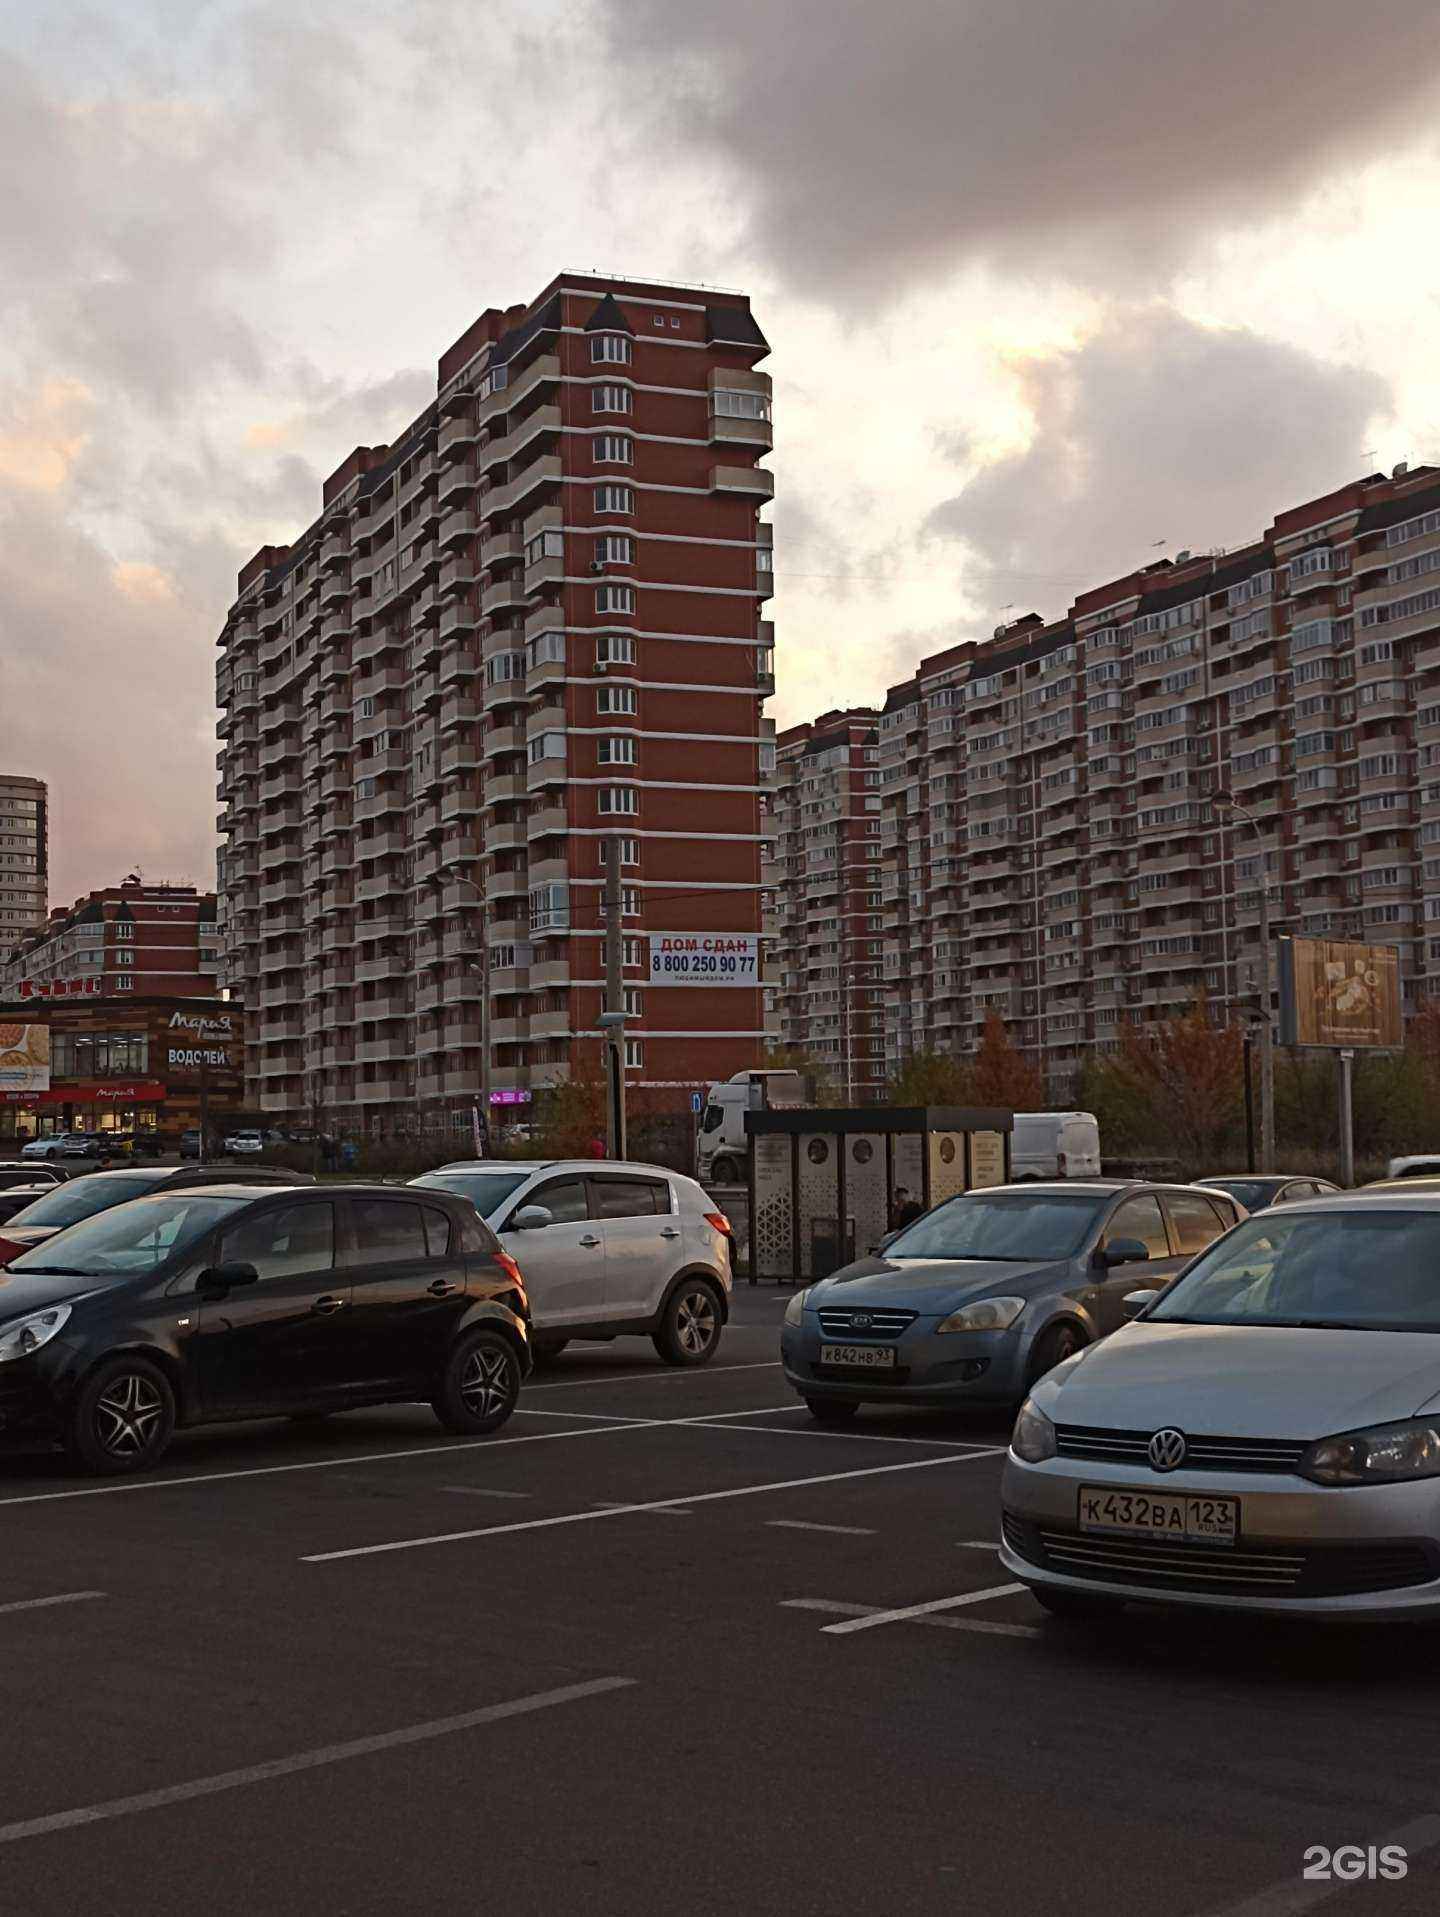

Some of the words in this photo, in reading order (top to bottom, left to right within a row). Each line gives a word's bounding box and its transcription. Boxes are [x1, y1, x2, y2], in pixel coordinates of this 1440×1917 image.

[661, 938, 698, 953] ДОМ
[702, 939, 748, 954] СДАН
[652, 955, 661, 972] 8
[664, 955, 689, 972] 800
[692, 956, 717, 972] 250
[720, 956, 736, 972] 90
[739, 956, 755, 972] 77
[1087, 1494, 1183, 1530] К432ВА
[1189, 1501, 1229, 1524] 123
